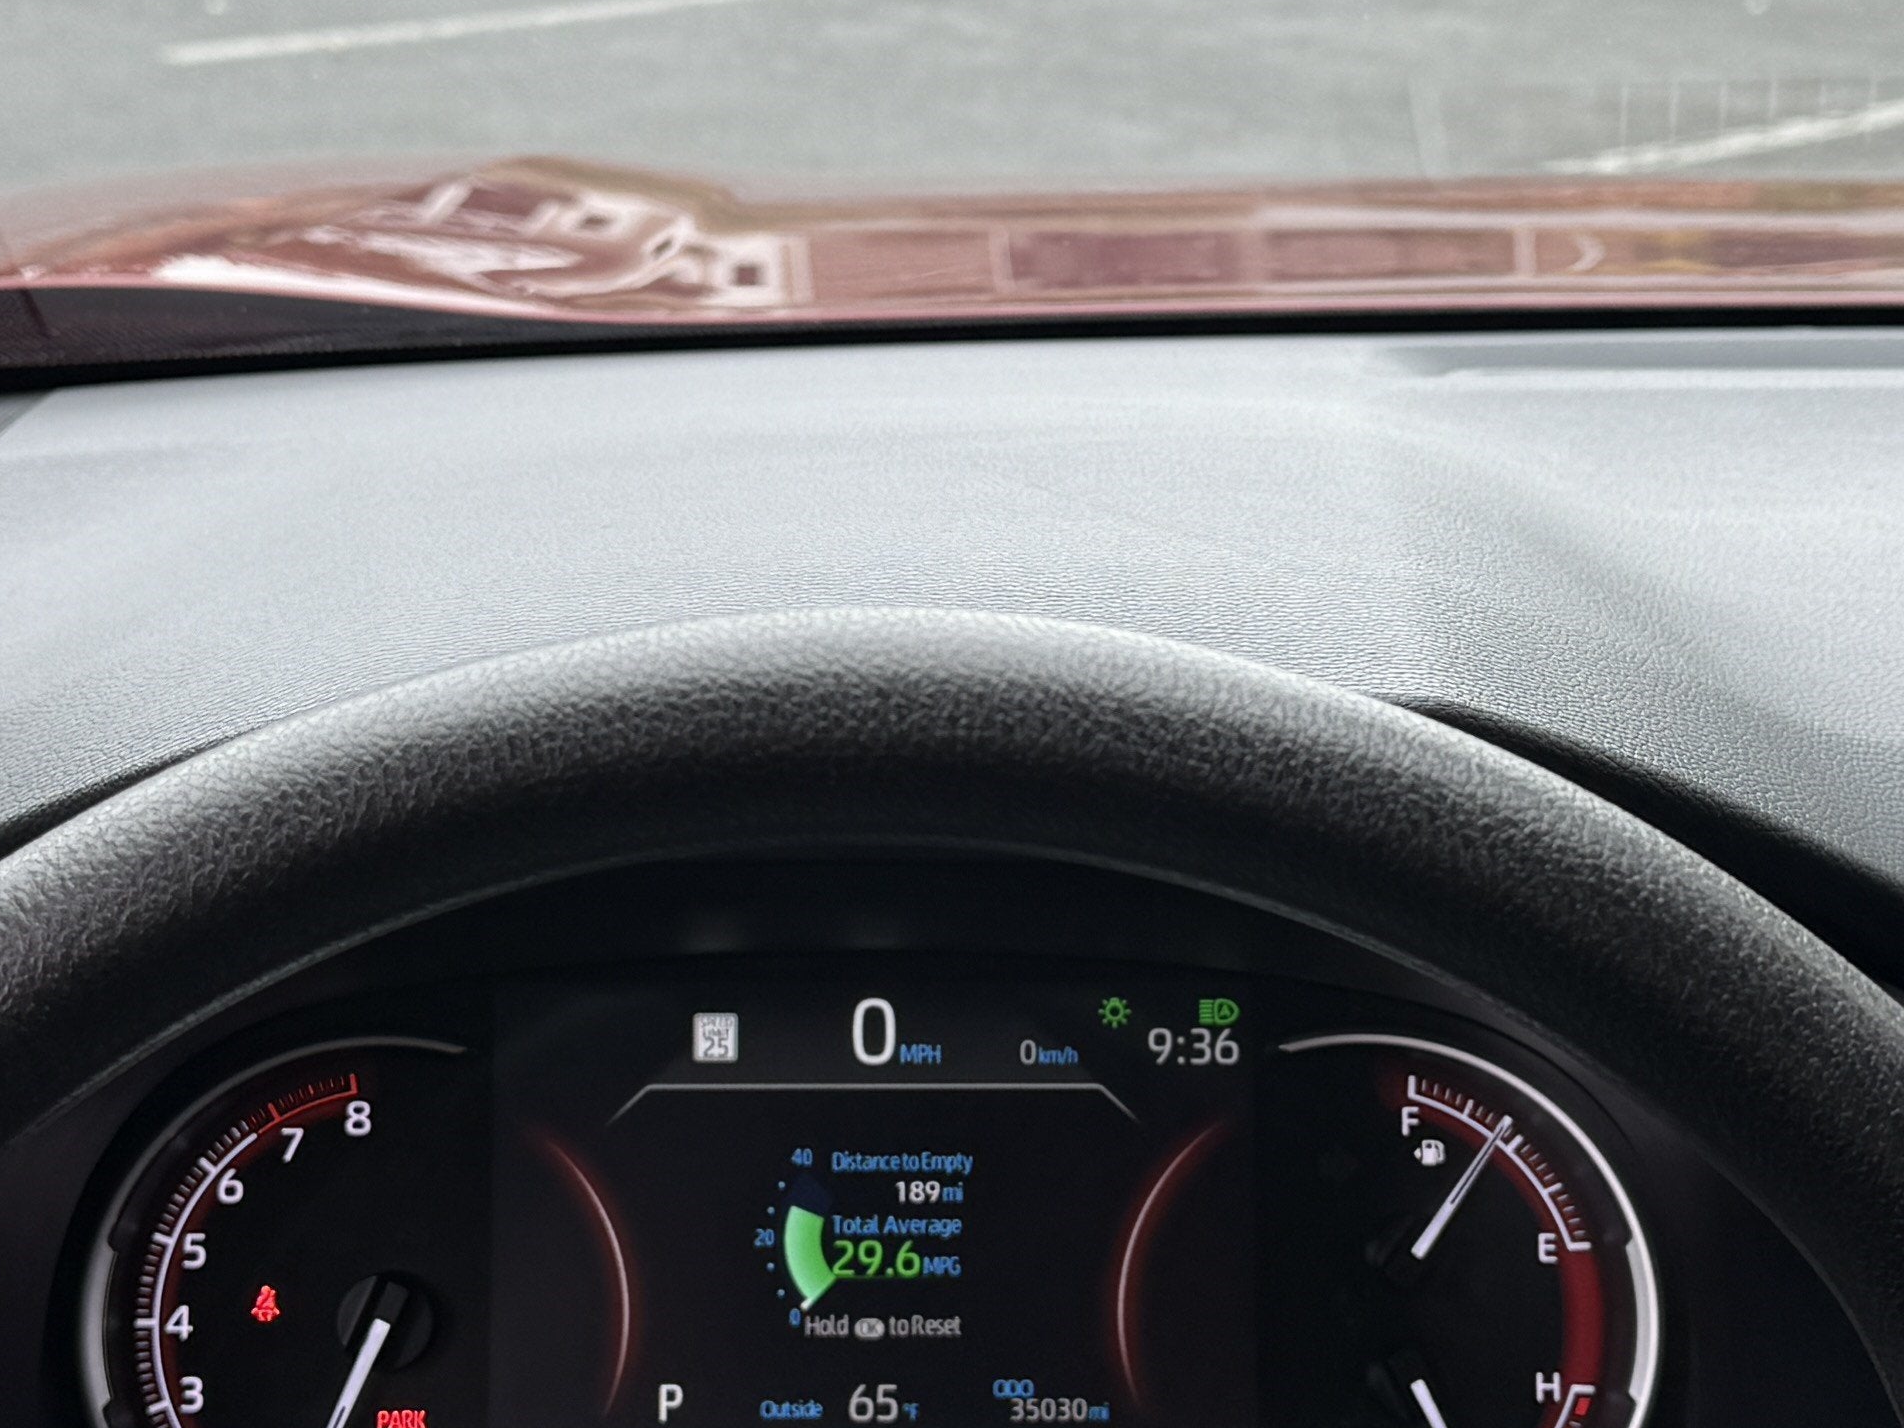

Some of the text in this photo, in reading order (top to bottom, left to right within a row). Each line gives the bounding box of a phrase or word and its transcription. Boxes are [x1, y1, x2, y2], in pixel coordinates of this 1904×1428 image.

[702, 1036, 729, 1059] 25
[852, 997, 942, 1066] 0 MPH
[1147, 1028, 1240, 1067] 9:36
[343, 1100, 372, 1137] 8
[1400, 1106, 1420, 1137] F
[280, 1127, 305, 1162] 7
[791, 1148, 814, 1167] 40
[831, 1151, 973, 1175] Distance to Empty
[216, 1168, 245, 1205] 6
[896, 1180, 941, 1204] 189
[754, 1228, 776, 1248] 20
[832, 1214, 962, 1237] Total Average
[181, 1232, 207, 1270] 5
[832, 1239, 961, 1276] 29.6 MPG
[1538, 1232, 1559, 1264] E
[164, 1304, 194, 1342] 4
[804, 1314, 849, 1336] Hold
[889, 1315, 910, 1336] to
[911, 1314, 961, 1336] Reset
[180, 1376, 205, 1415] 3
[658, 1383, 684, 1423] P
[759, 1399, 824, 1420] Outside
[848, 1383, 899, 1423] 65
[992, 1379, 1035, 1399] ODO
[1535, 1371, 1562, 1404] H
[1009, 1398, 1088, 1423] 35030
